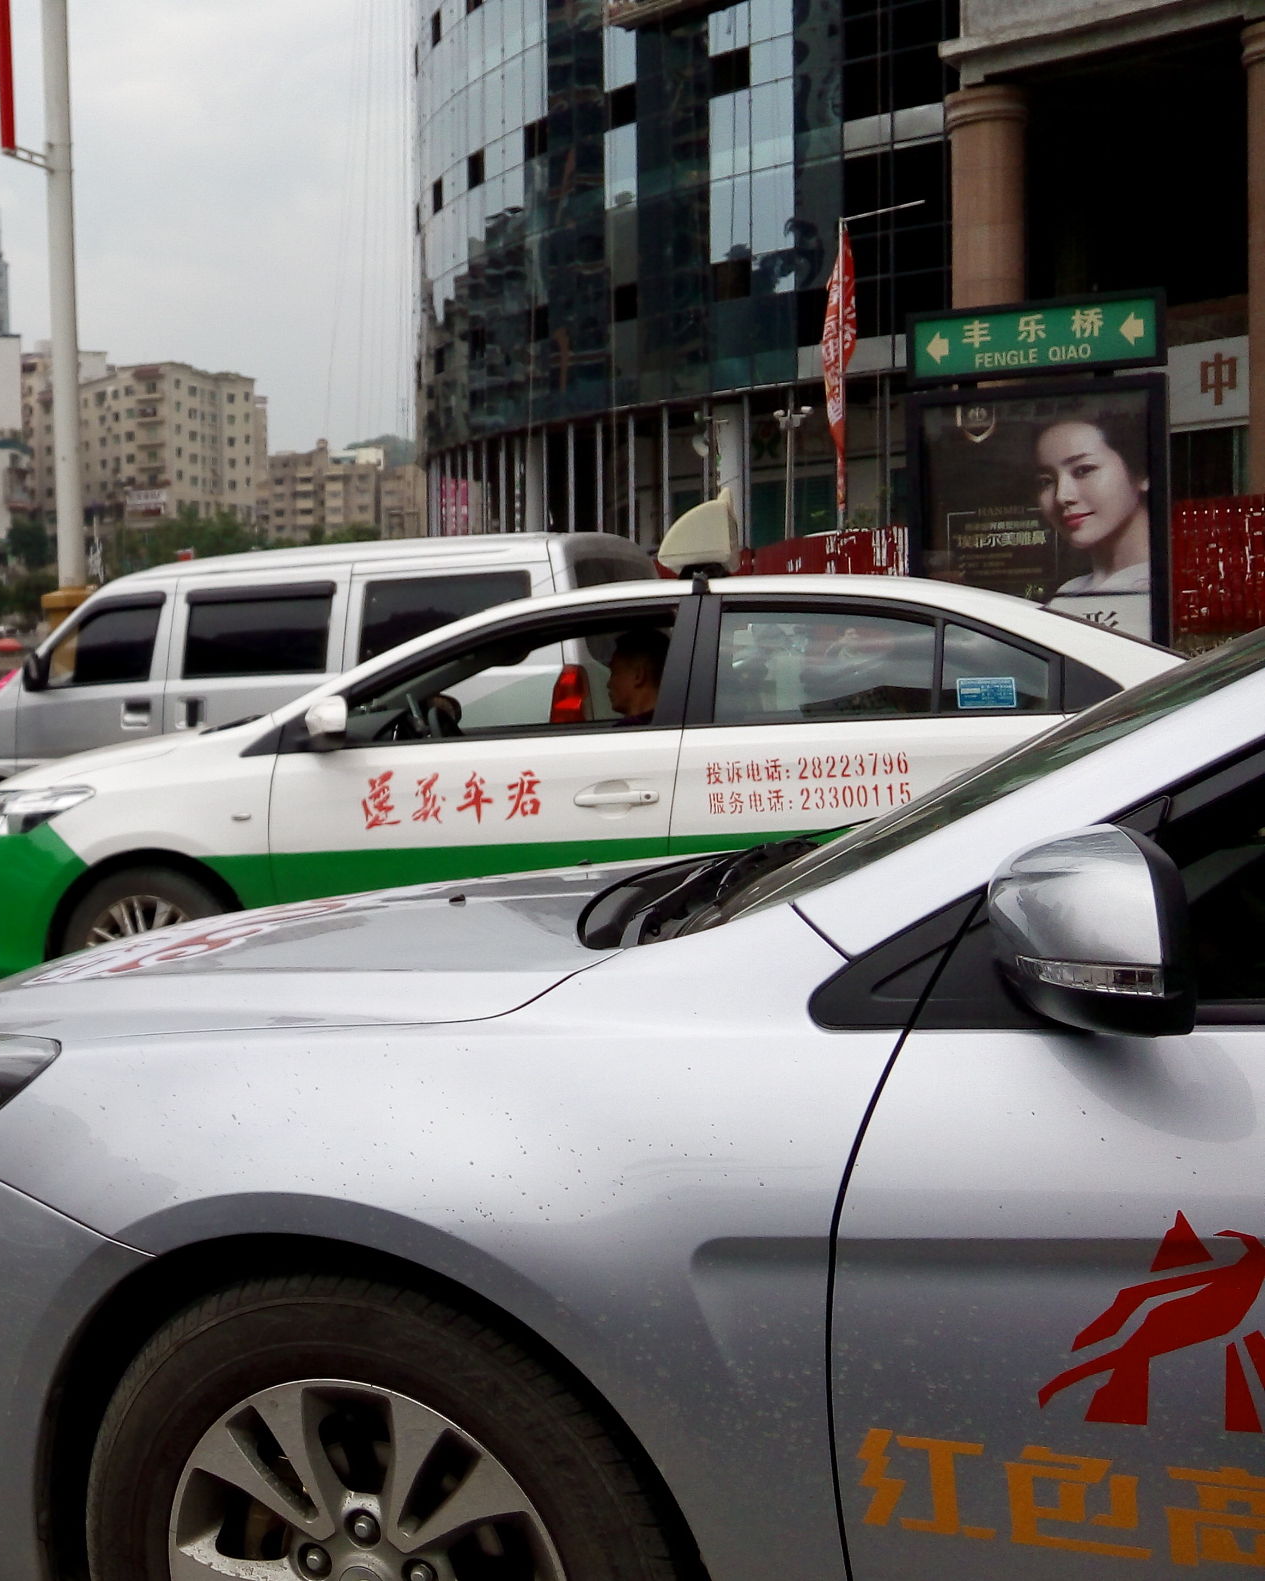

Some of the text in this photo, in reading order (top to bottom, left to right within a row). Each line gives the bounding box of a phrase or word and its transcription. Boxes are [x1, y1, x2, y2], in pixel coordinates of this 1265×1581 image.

[962, 308, 1104, 348] 丰乐桥
[975, 343, 1092, 369] FENGLE QIAO
[1200, 352, 1237, 406] 中
